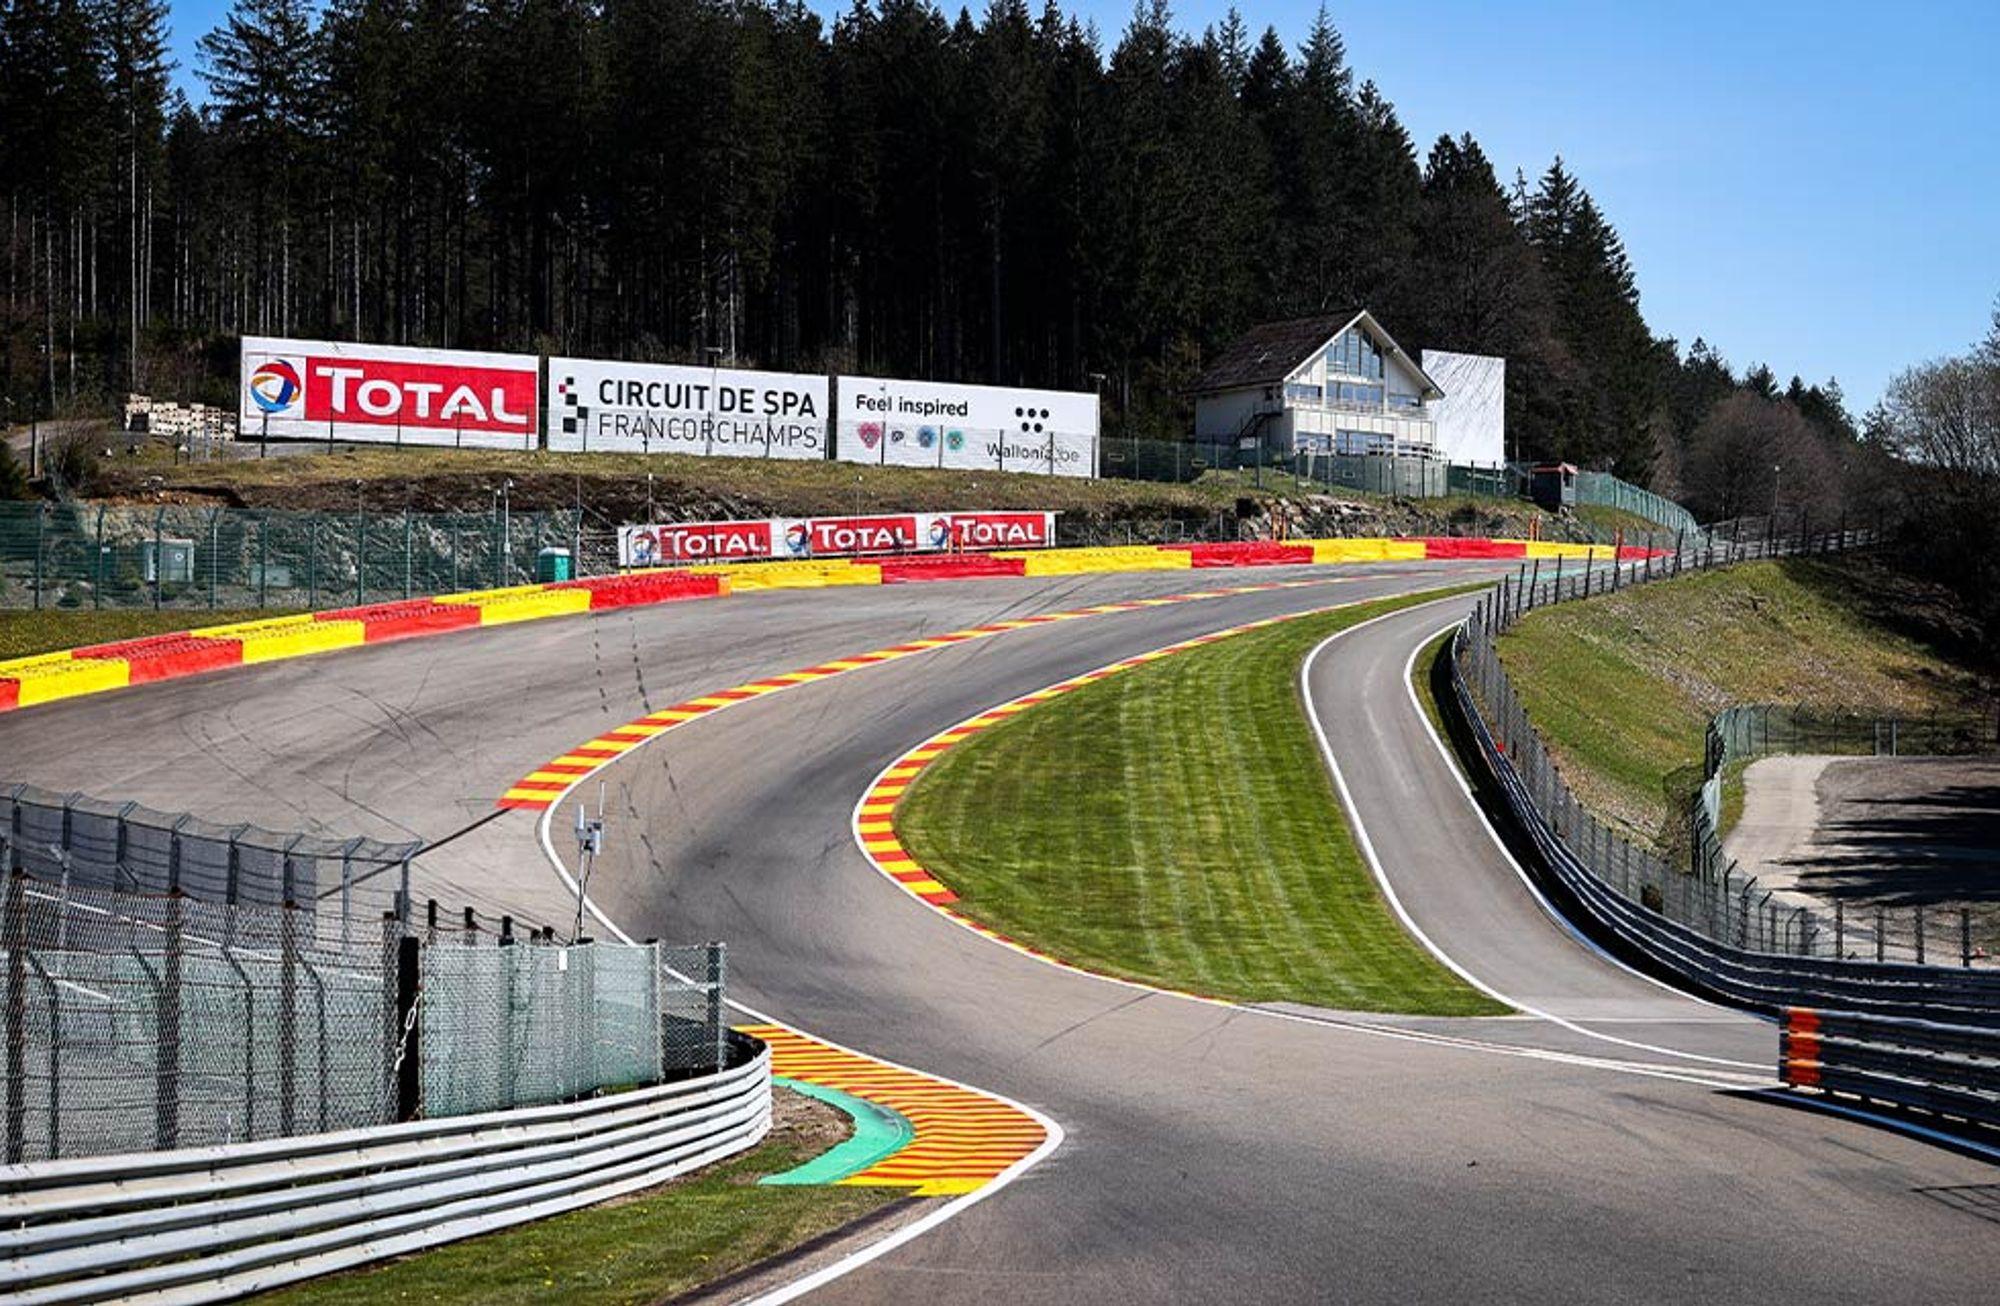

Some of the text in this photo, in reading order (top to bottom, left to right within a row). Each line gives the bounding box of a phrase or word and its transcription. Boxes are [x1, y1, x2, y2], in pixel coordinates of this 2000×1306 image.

[315, 366, 528, 424] TOTAL
[599, 379, 817, 418] CIRCUIT DE SPA
[856, 394, 968, 418] Feel inspired
[599, 413, 817, 449] FRANCORCHAMPS
[664, 530, 768, 555] TOTAL
[816, 524, 913, 548] TOTAL
[954, 519, 1042, 543] TOTAL
